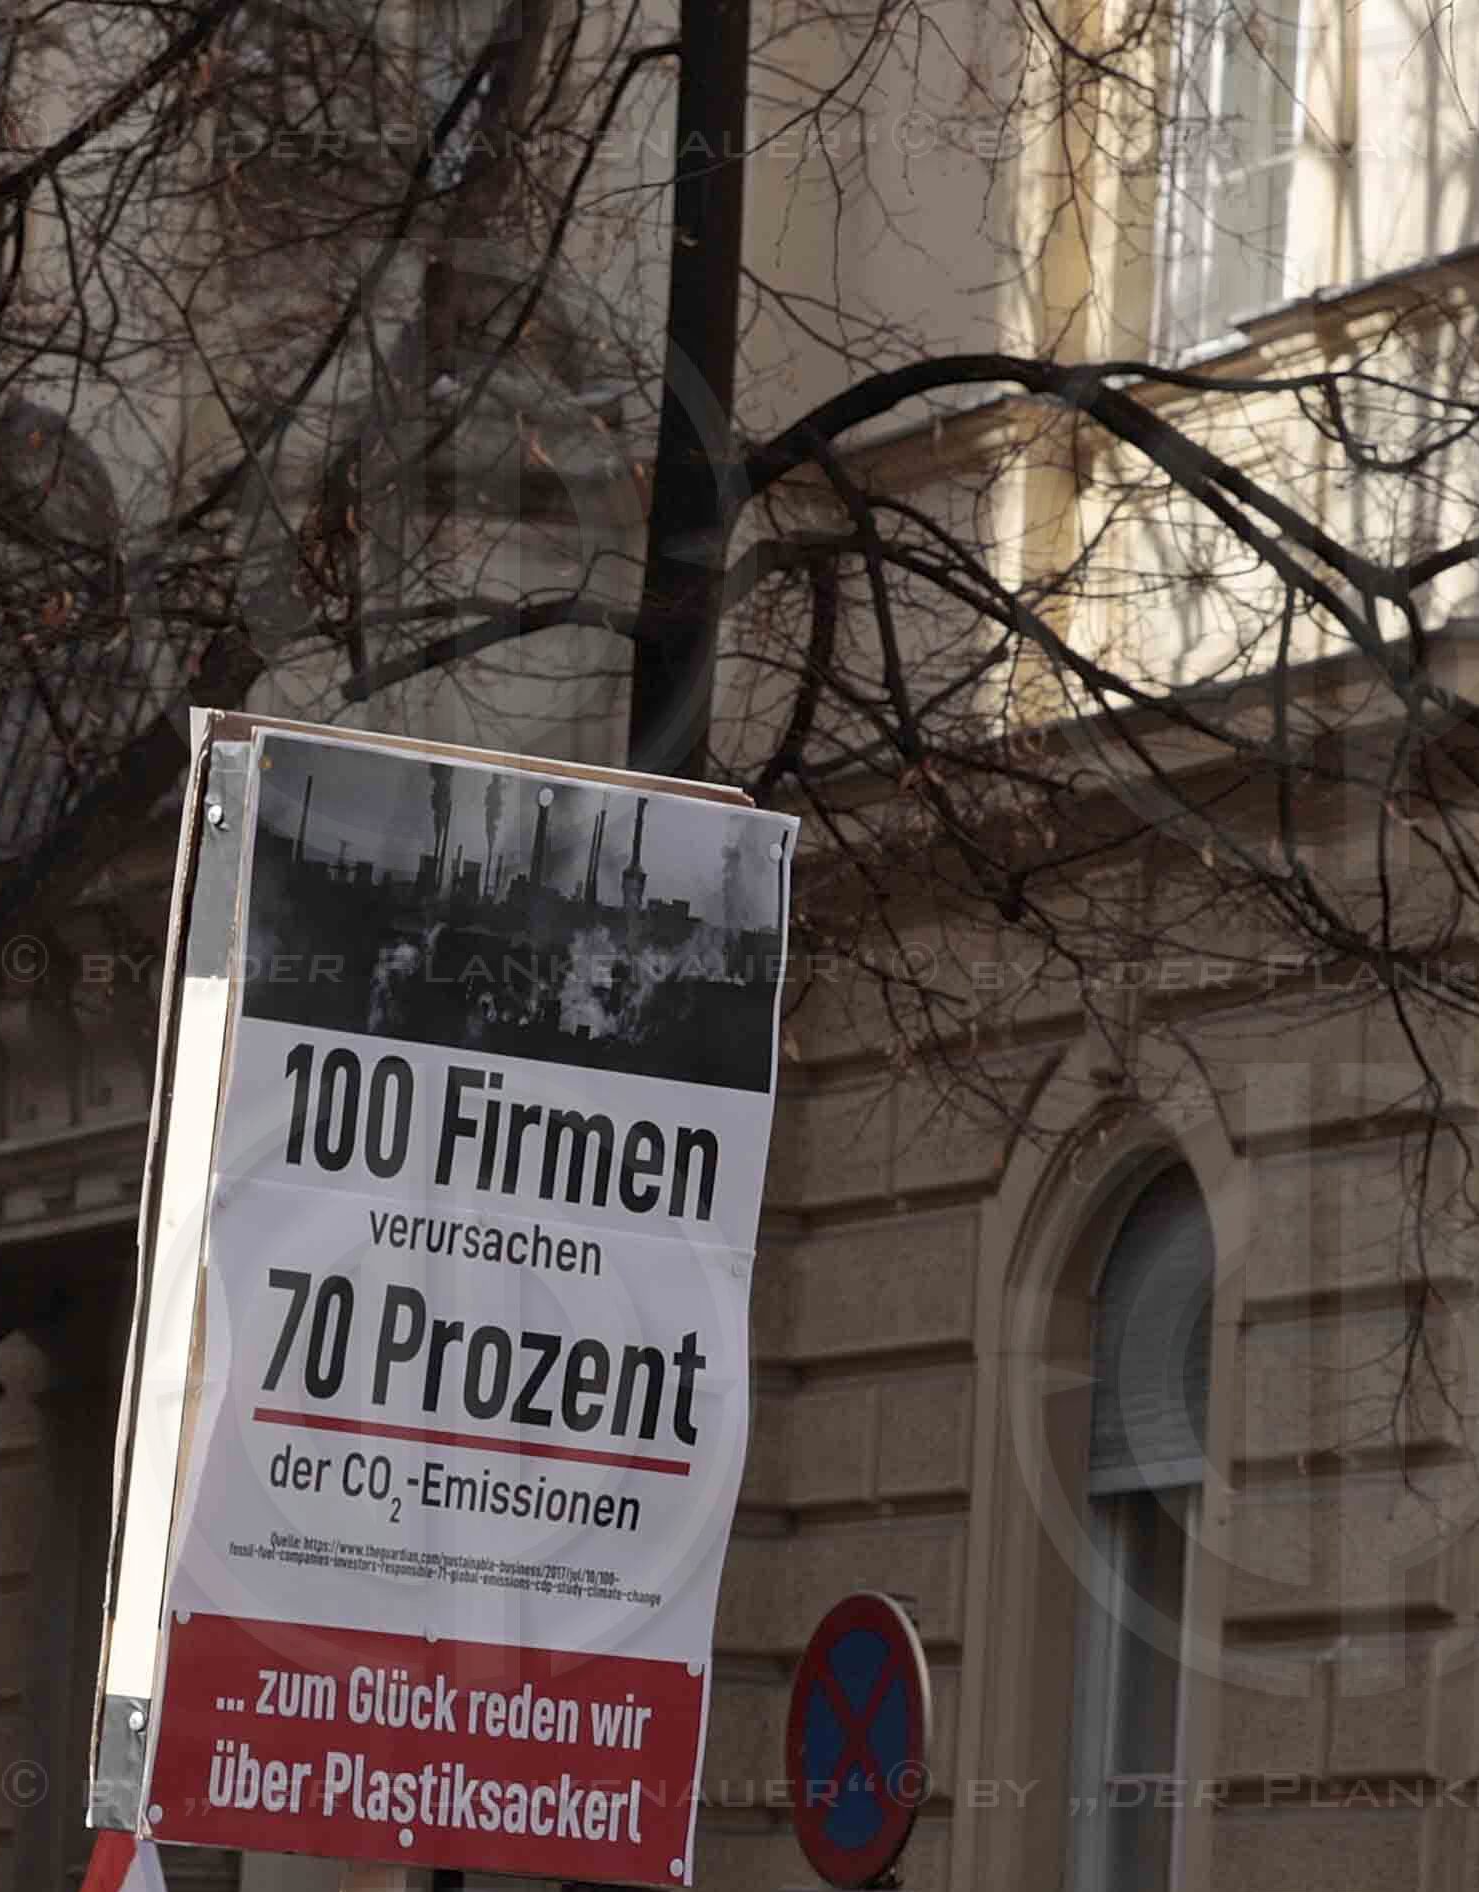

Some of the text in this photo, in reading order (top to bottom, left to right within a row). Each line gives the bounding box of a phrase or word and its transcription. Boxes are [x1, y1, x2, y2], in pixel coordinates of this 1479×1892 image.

[284, 1042, 719, 1221] 100 Firmen
[369, 1209, 602, 1276] verursachen
[261, 1267, 706, 1447] 70 Prozent
[270, 1444, 331, 1492] der
[256, 1668, 336, 1721] zum
[348, 1665, 456, 1733] Glück
[468, 1684, 579, 1743] reden
[591, 1694, 652, 1751] wir
[208, 1739, 641, 1844] über Plastiksackerl
